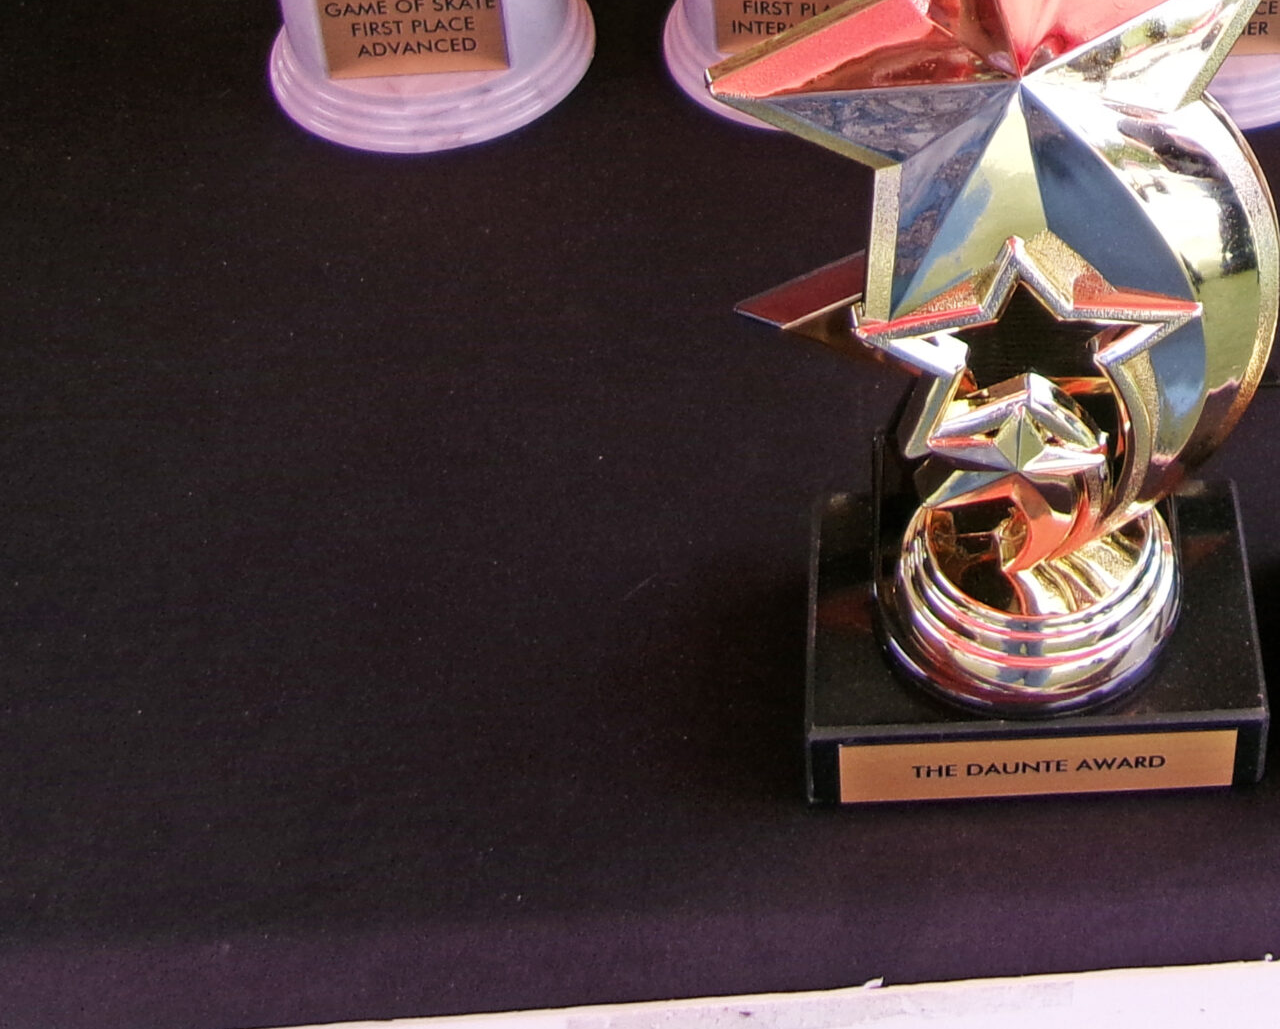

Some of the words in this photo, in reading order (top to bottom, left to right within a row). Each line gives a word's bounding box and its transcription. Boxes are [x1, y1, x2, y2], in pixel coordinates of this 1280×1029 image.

[324, 0, 388, 18] GAME
[742, 0, 793, 16] FIRST
[351, 19, 403, 37] FIRST
[411, 16, 475, 34] PLACE
[357, 37, 477, 58] ADVANCED
[911, 764, 958, 779] THE
[966, 758, 1069, 778] DAUNTE
[1075, 754, 1166, 772] AWARD
